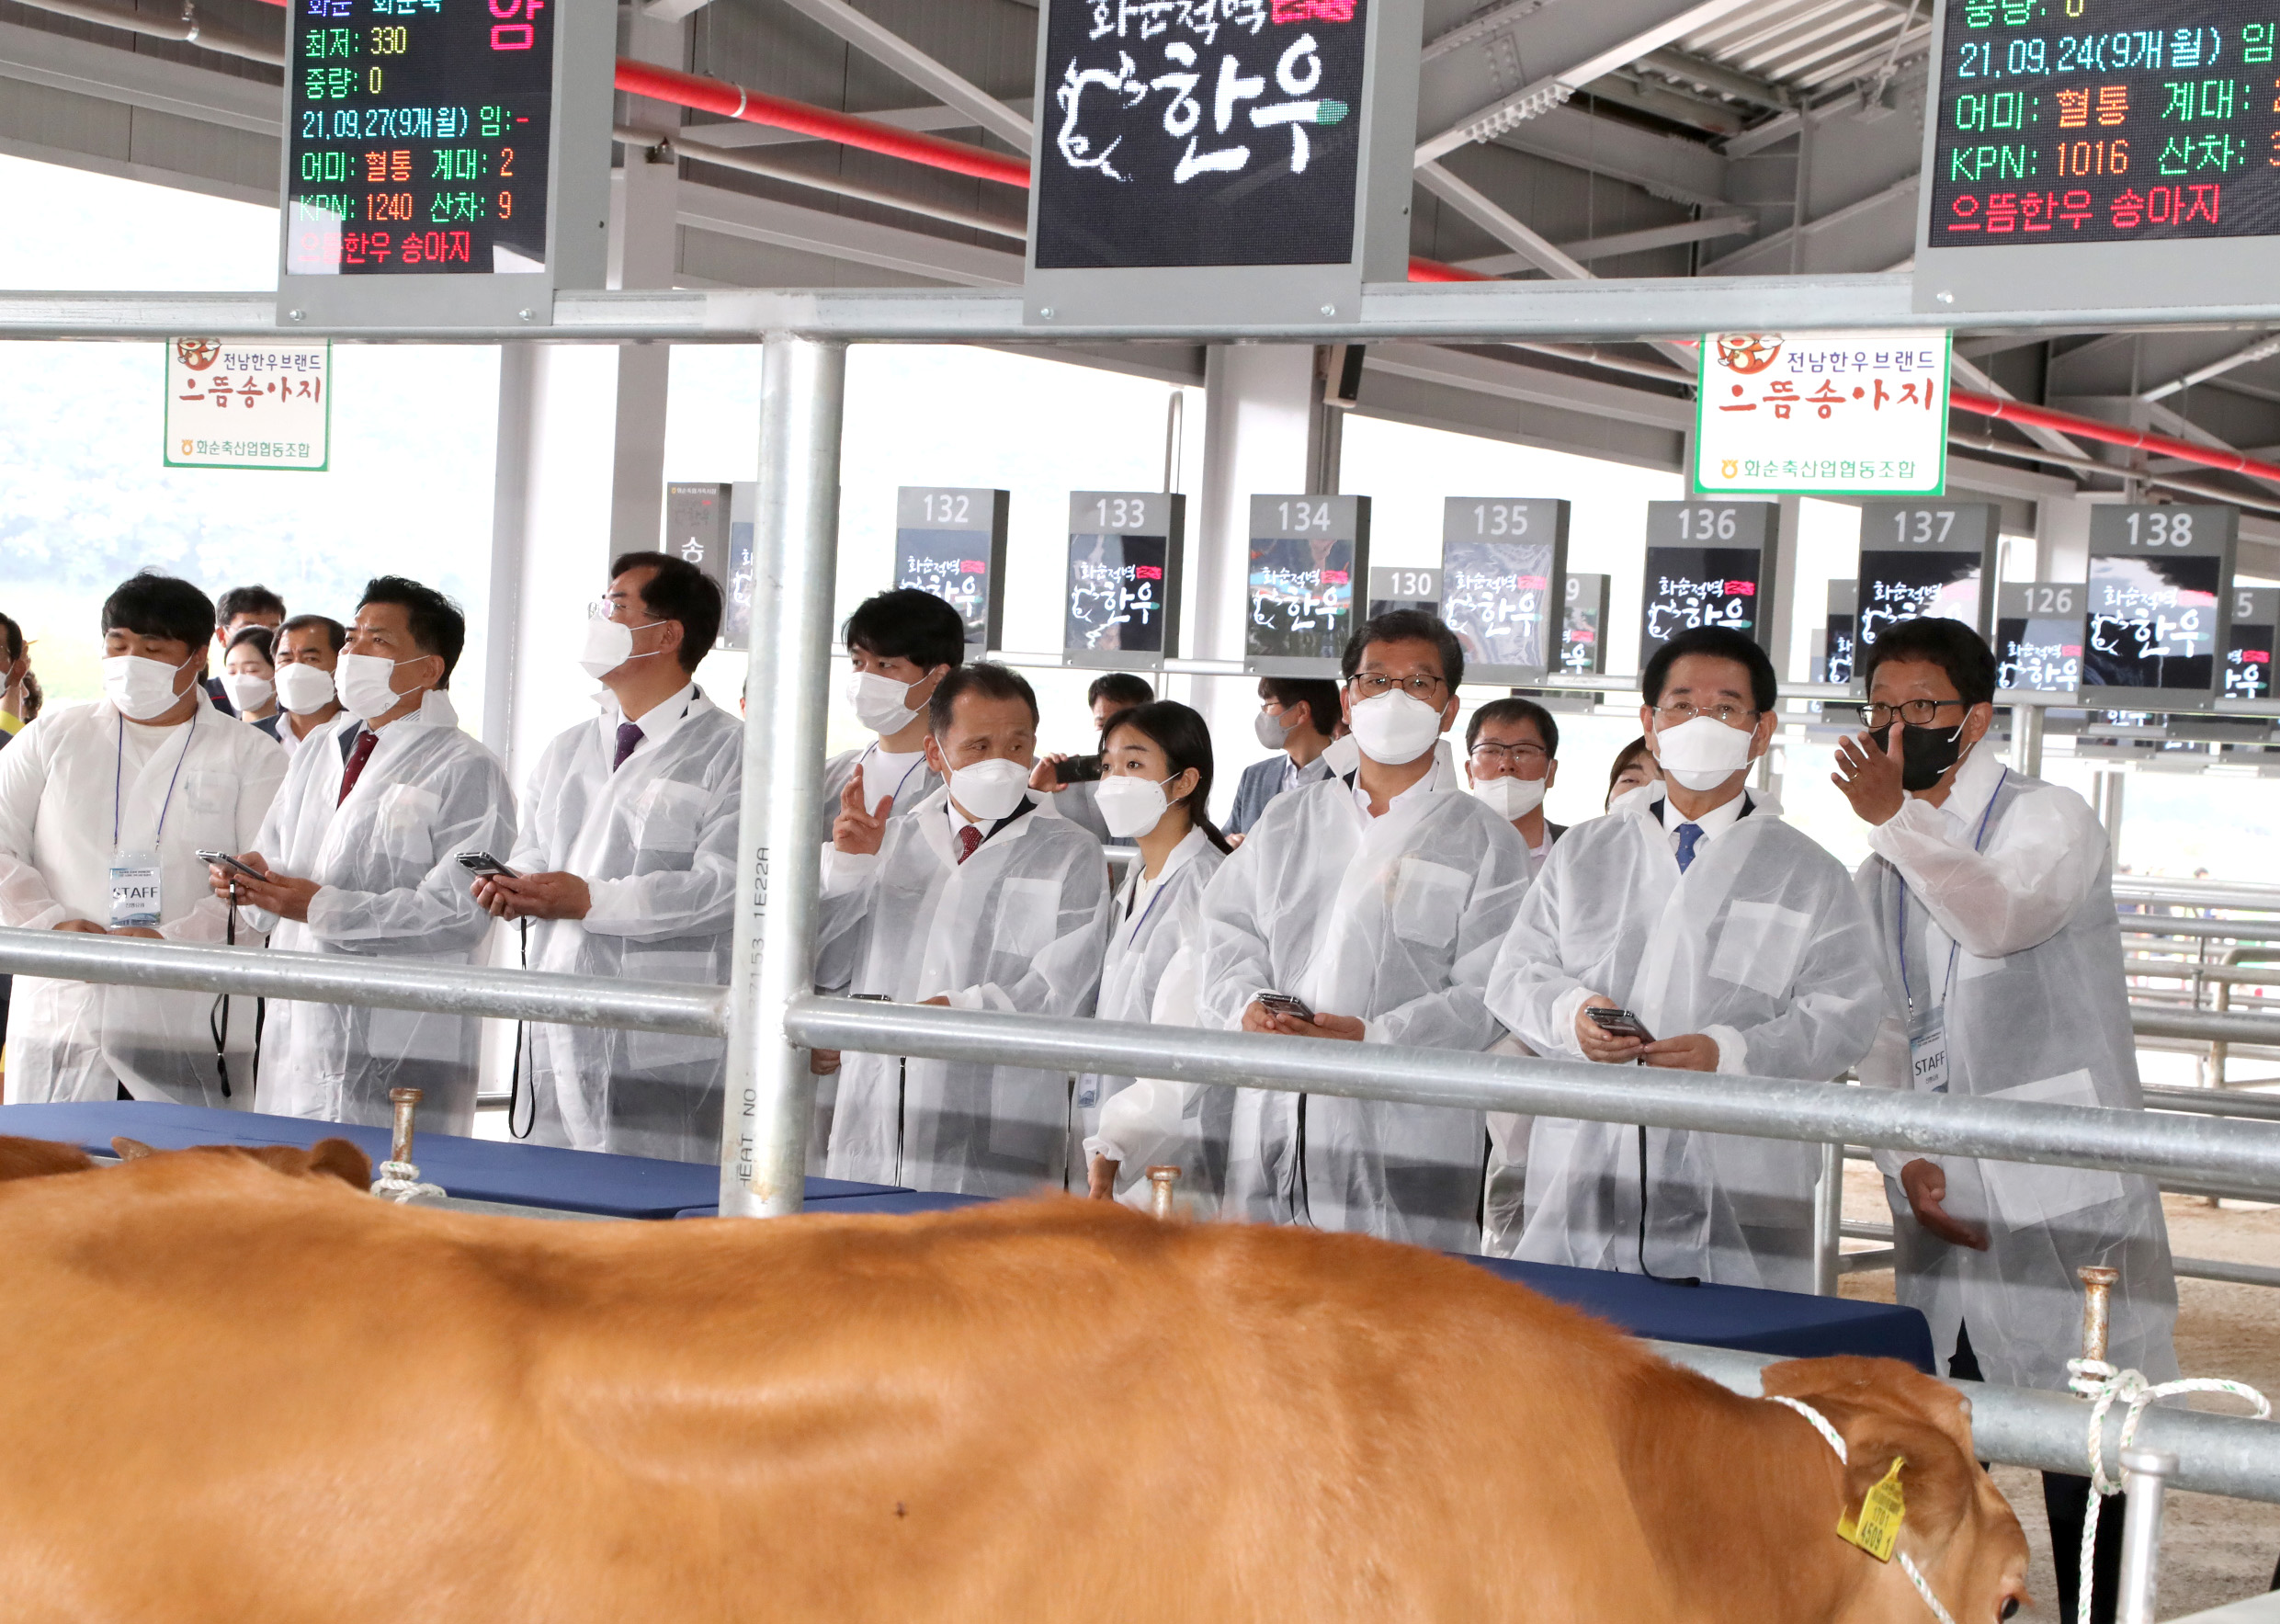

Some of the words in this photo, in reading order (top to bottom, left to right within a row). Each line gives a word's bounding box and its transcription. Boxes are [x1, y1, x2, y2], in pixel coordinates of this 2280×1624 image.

[305, 28, 359, 59] 최저:
[370, 27, 406, 54] 330
[305, 67, 357, 99] 중량:
[369, 66, 382, 94] 0
[1151, 33, 1350, 184] 한우
[1956, 91, 2038, 131] 어미:
[2056, 85, 2128, 128] 혈통
[2161, 79, 2251, 120] 계대:
[301, 152, 355, 182] 어미:
[365, 150, 413, 181] 혈통
[431, 148, 487, 180] 계대:
[499, 148, 514, 176] 2
[1951, 144, 2038, 181] KPN:
[2058, 139, 2128, 176] 1016
[2158, 133, 2245, 176] 산차:
[367, 193, 413, 221] 1240
[430, 191, 484, 222] 산차:
[498, 191, 512, 220] 9
[1947, 189, 2093, 233] 으뜸한우
[2110, 184, 2220, 228] 송아지
[401, 231, 471, 263] 송아지
[179, 376, 321, 408] 으뜸송아지
[1719, 377, 1934, 419] 으뜸송아지
[197, 439, 310, 458] 화순축산업협동조합
[1744, 460, 1915, 478] 화순축산업협동조합
[924, 494, 970, 523] 132
[1096, 498, 1146, 528] 133
[1278, 502, 1331, 531] 134
[1474, 505, 1528, 536] 135
[1678, 508, 1737, 539] 136
[1894, 510, 1956, 543] 137
[2126, 512, 2193, 547] 138
[908, 555, 960, 577] 화순적벽
[1081, 562, 1137, 584] 화순적벽
[1262, 566, 1321, 588] 화순적벽
[1391, 573, 1432, 596] 130
[1455, 571, 1518, 594] 화순적벽
[1659, 576, 1724, 600] 화순적벽
[1101, 581, 1160, 625] 한우
[1285, 585, 1346, 631] 한우
[1477, 591, 1543, 638] 한우
[2025, 587, 2072, 613] 126
[2129, 608, 2210, 660] 한우
[112, 887, 158, 900] STAFF
[1915, 1050, 1945, 1076] STAFF
